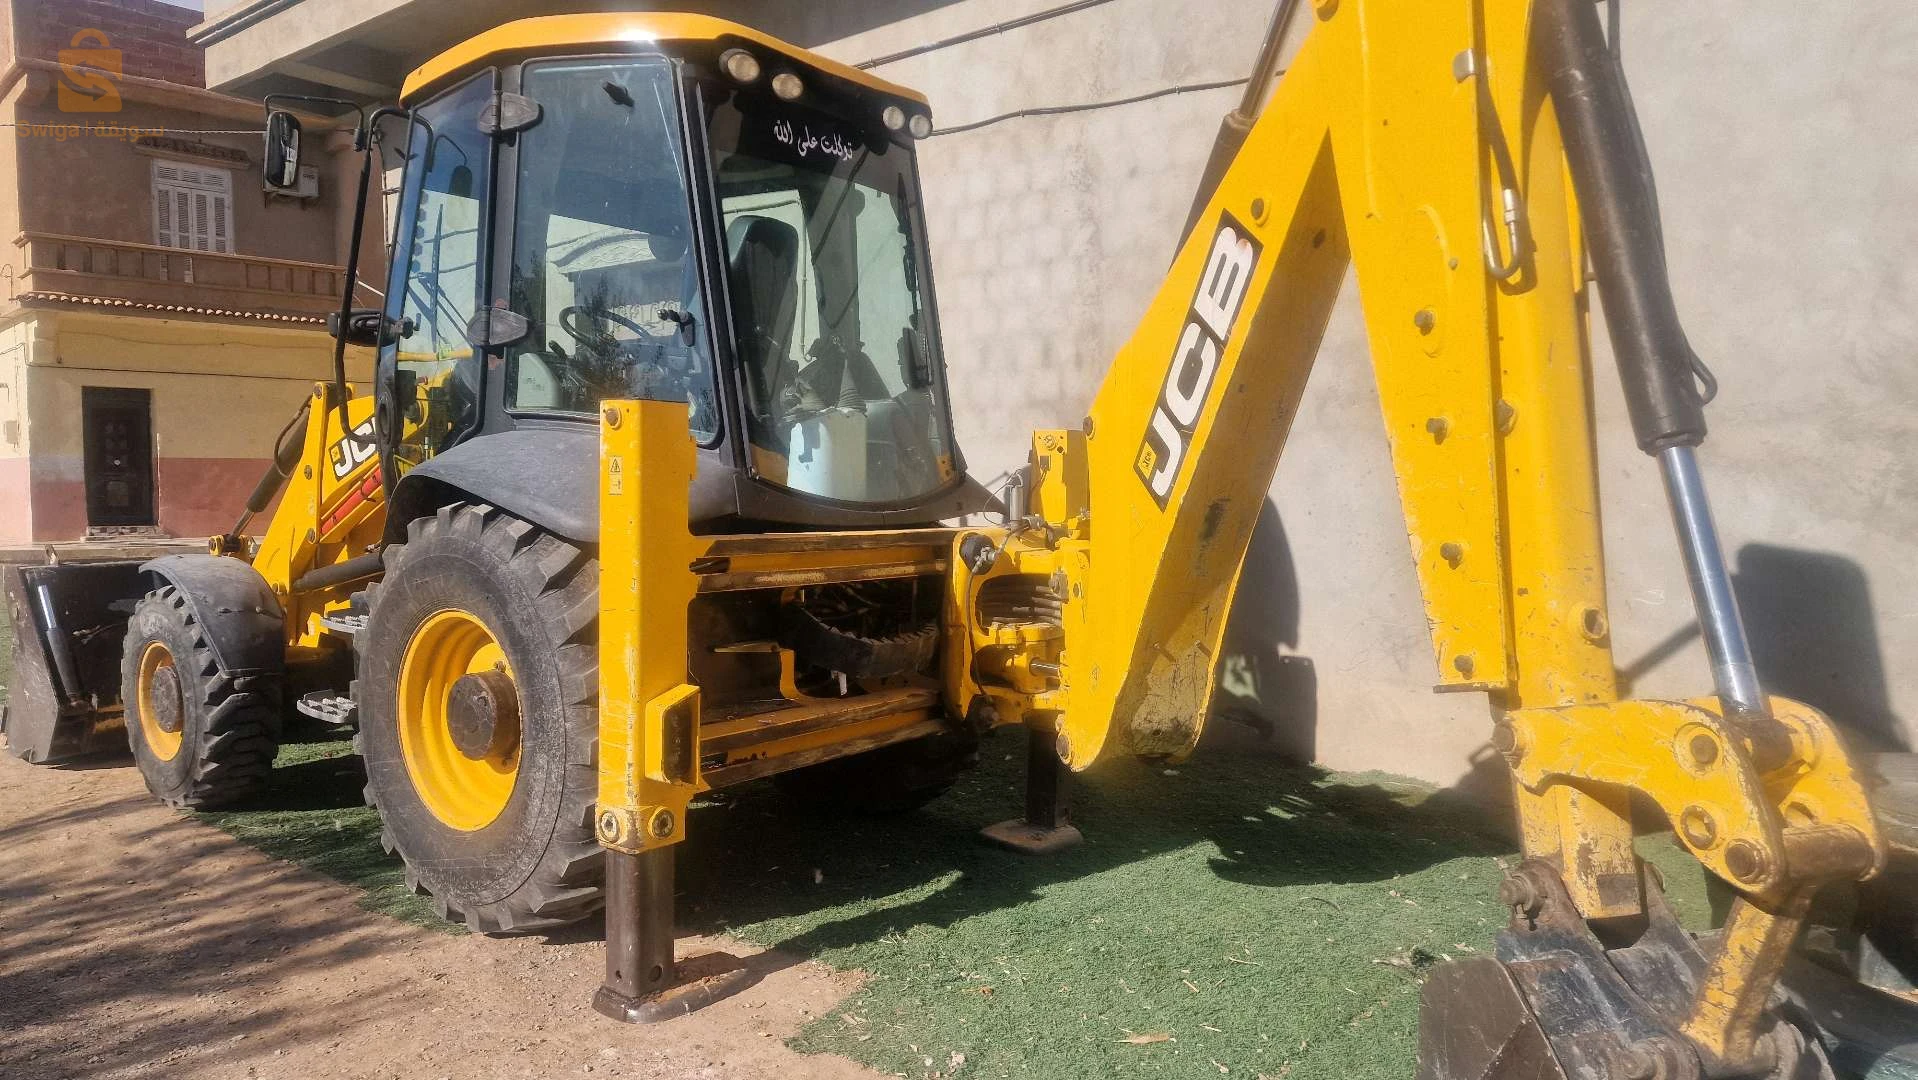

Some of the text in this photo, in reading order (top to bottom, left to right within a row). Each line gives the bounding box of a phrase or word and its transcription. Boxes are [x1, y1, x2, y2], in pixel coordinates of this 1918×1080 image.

[773, 119, 853, 161] توكلت على الله
[1151, 226, 1254, 497] JCB
[334, 416, 377, 476] JC
